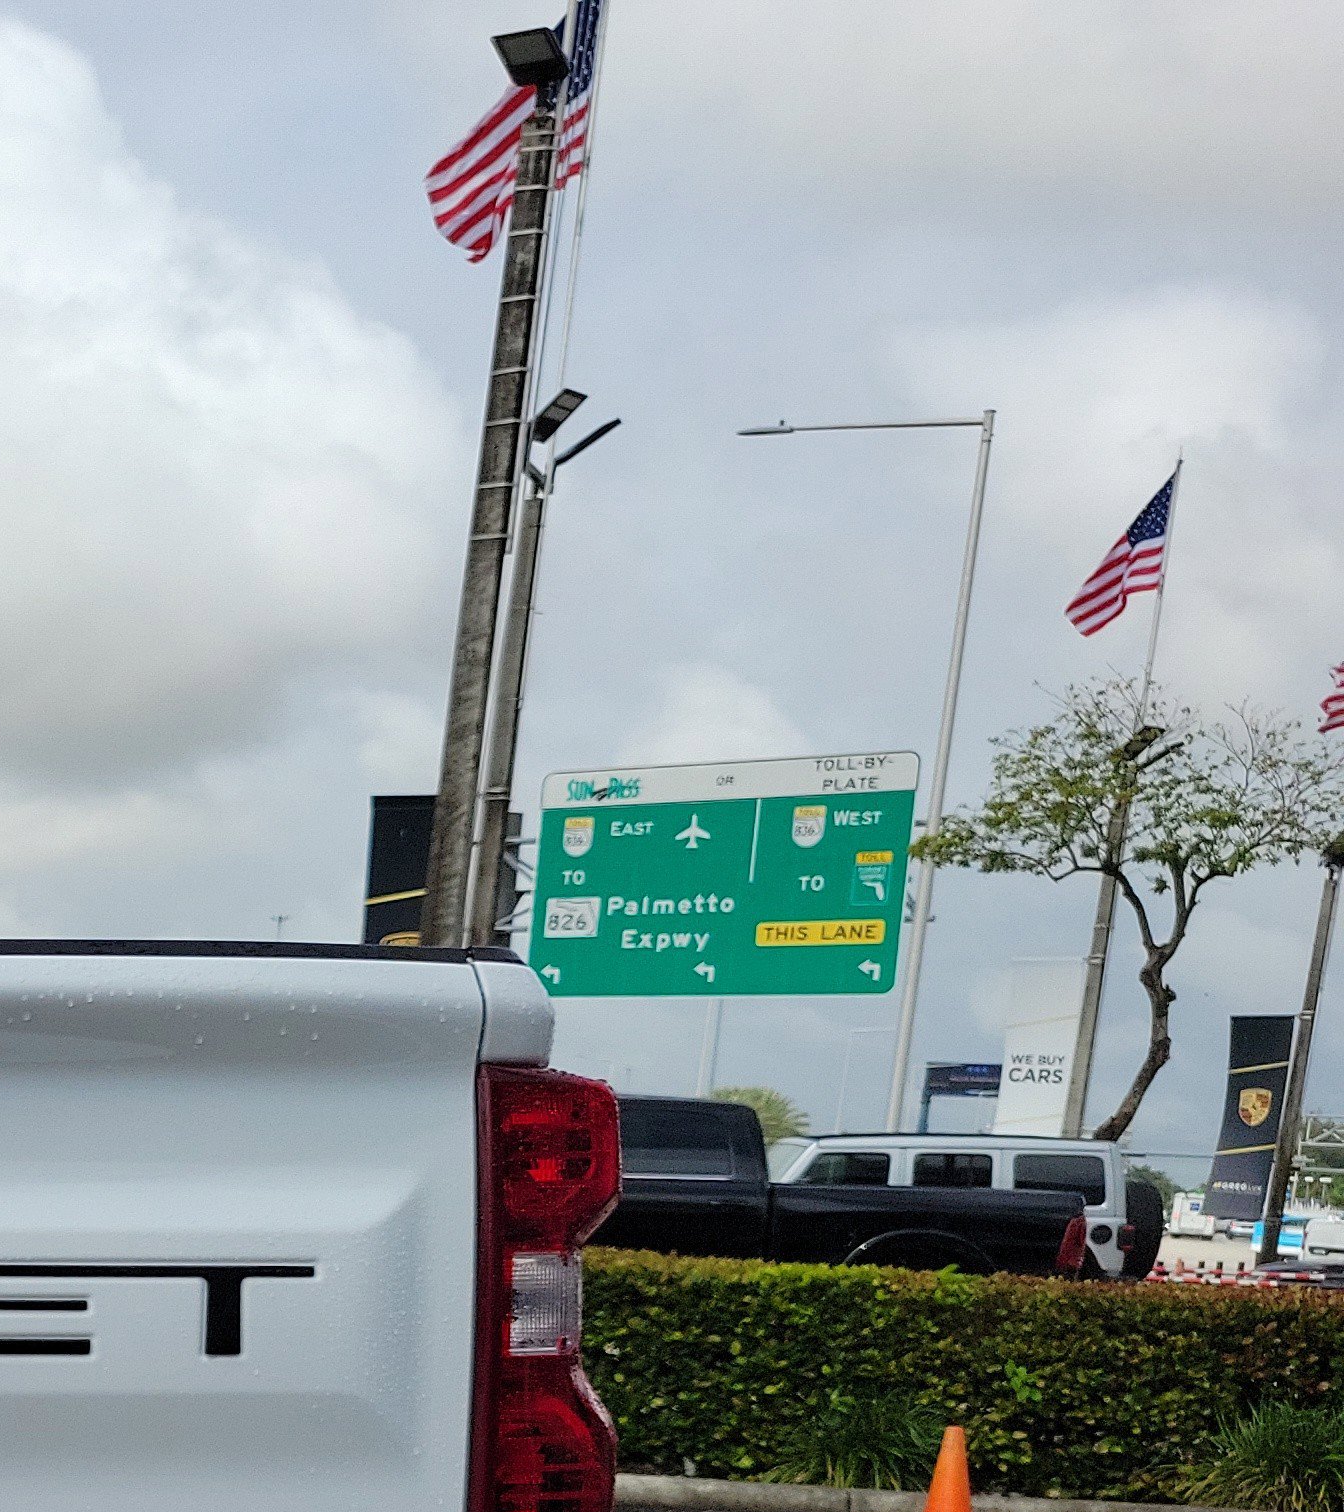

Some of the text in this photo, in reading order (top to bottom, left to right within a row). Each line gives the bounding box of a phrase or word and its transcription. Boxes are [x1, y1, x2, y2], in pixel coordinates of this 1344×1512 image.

[822, 777, 880, 791] PLATE
[833, 810, 883, 827] WEST
[610, 820, 655, 837] EAST
[562, 869, 586, 886] TO
[798, 875, 825, 892] TO
[607, 893, 736, 916] Palmetto
[547, 913, 587, 931] 826
[620, 928, 710, 953] Expwy
[764, 924, 877, 942] THIS LANE
[1012, 1054, 1065, 1065] WE BUY
[1009, 1067, 1063, 1084] CARS
